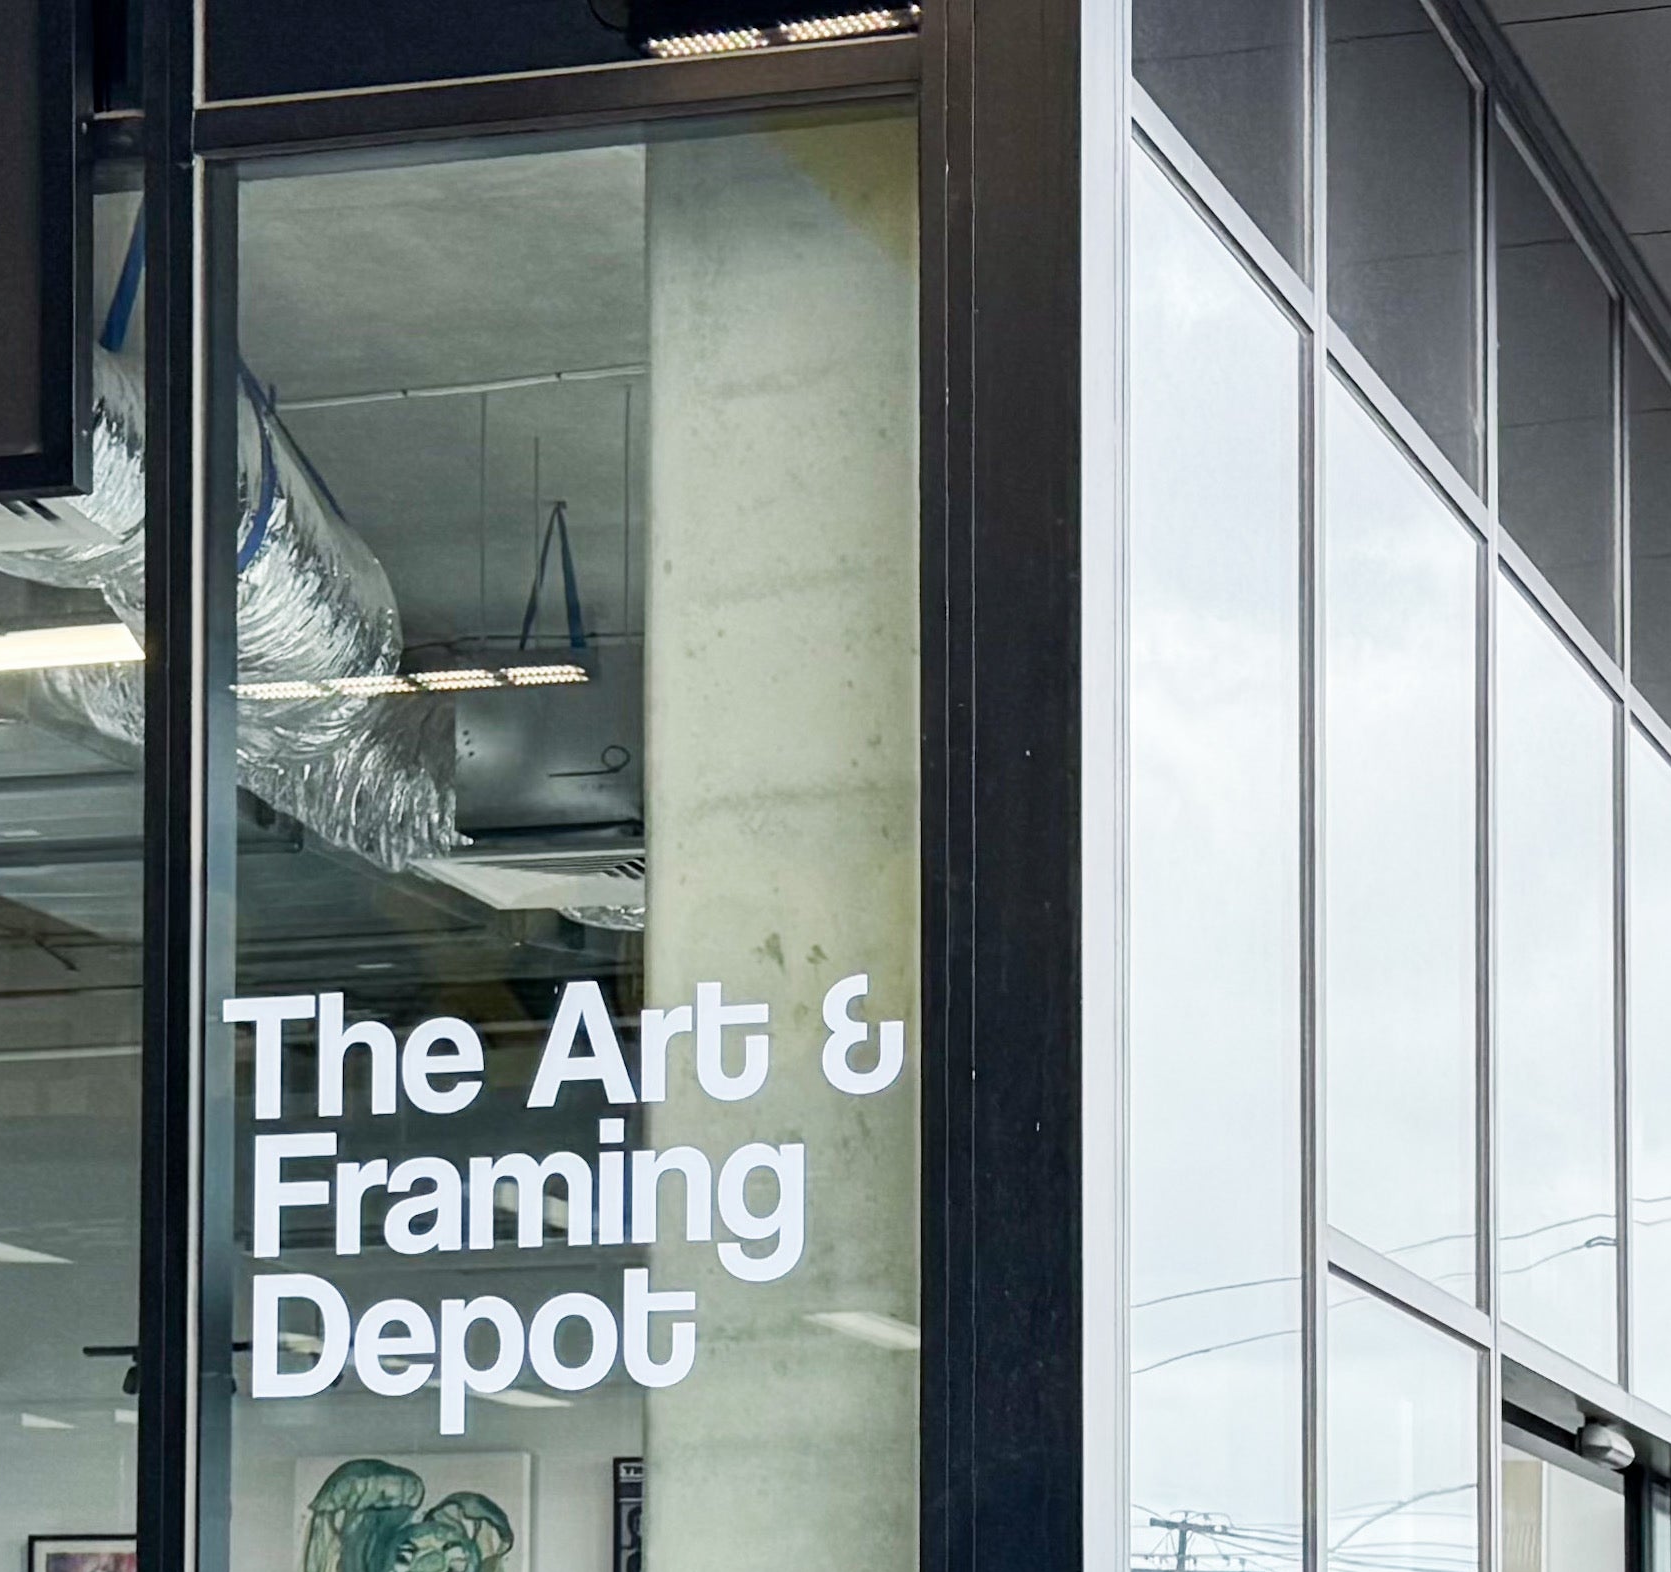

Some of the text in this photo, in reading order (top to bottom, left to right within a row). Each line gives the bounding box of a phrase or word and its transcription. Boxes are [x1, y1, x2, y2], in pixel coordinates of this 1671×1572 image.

[223, 974, 904, 1120] The Art &
[253, 1117, 805, 1282] Framing
[251, 1267, 697, 1435] Depot
